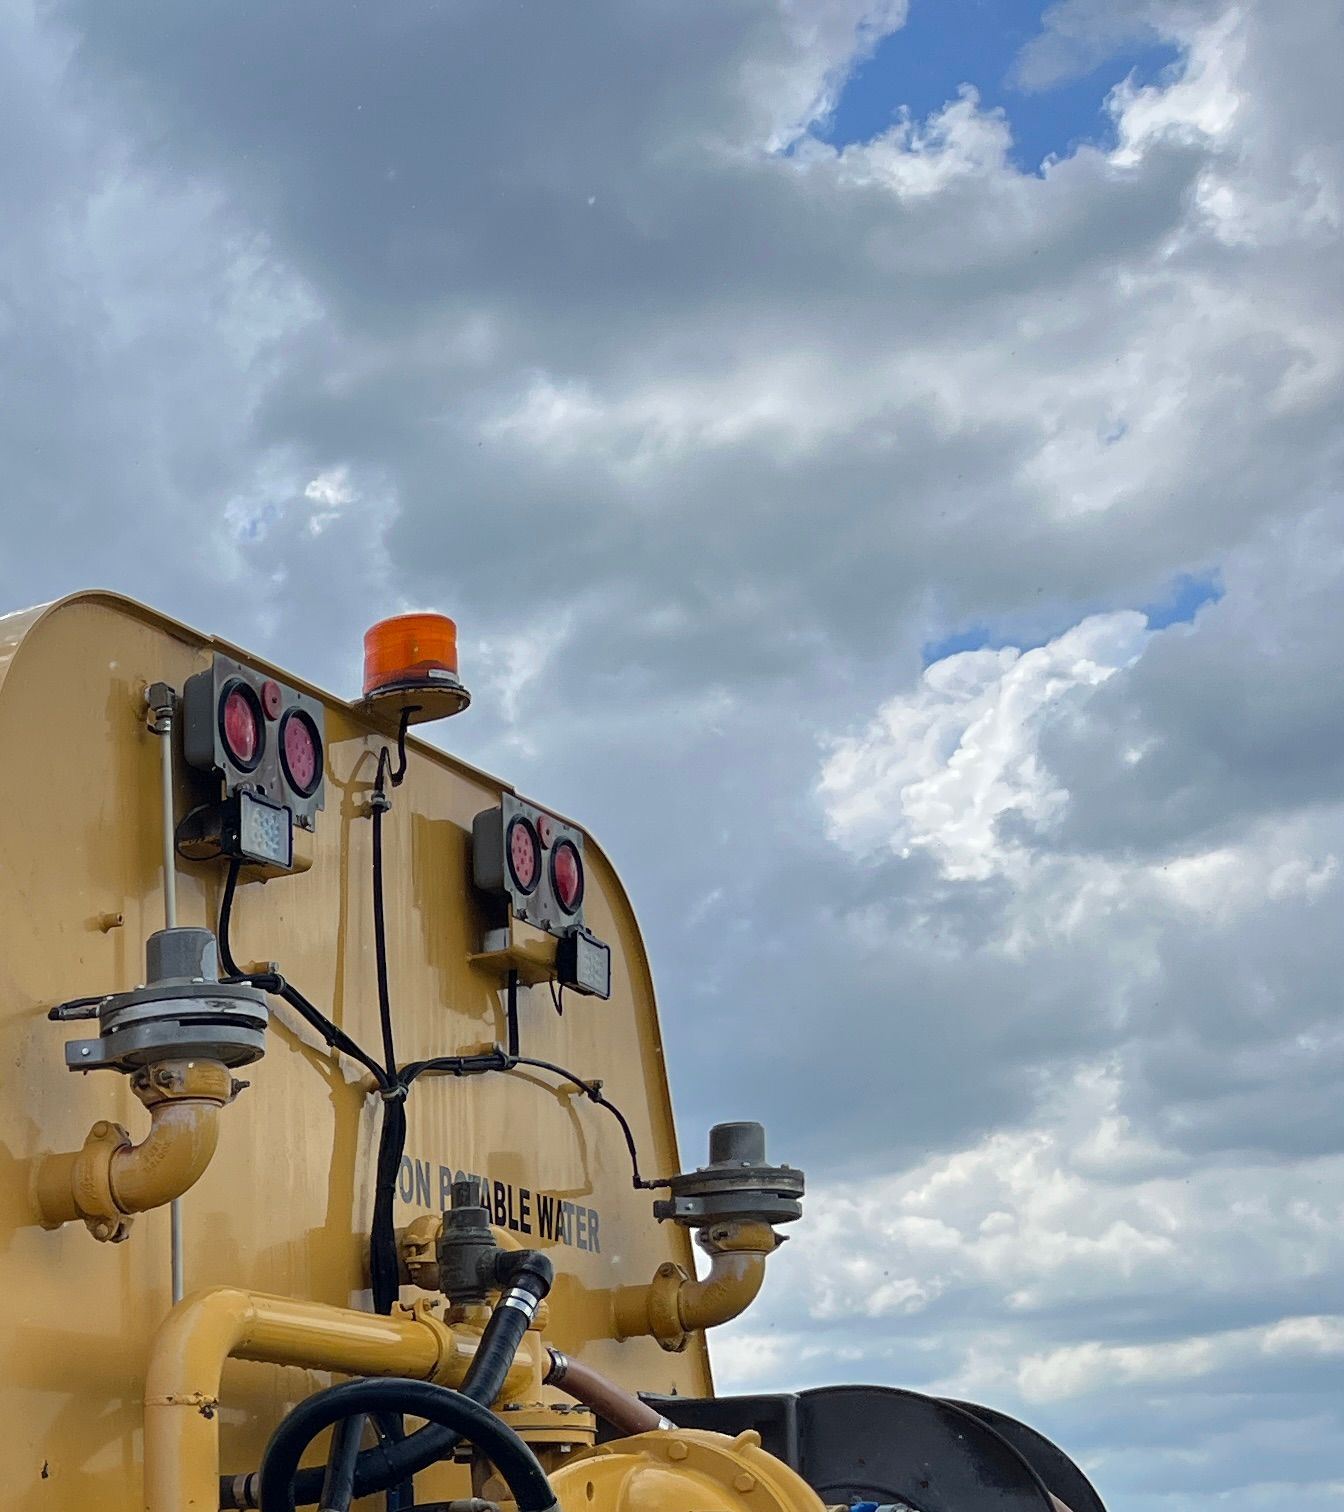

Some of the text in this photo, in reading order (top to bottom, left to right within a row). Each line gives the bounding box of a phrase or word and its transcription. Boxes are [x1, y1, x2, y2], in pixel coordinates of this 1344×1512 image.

[393, 1155, 600, 1253] ON PABLE WATER
